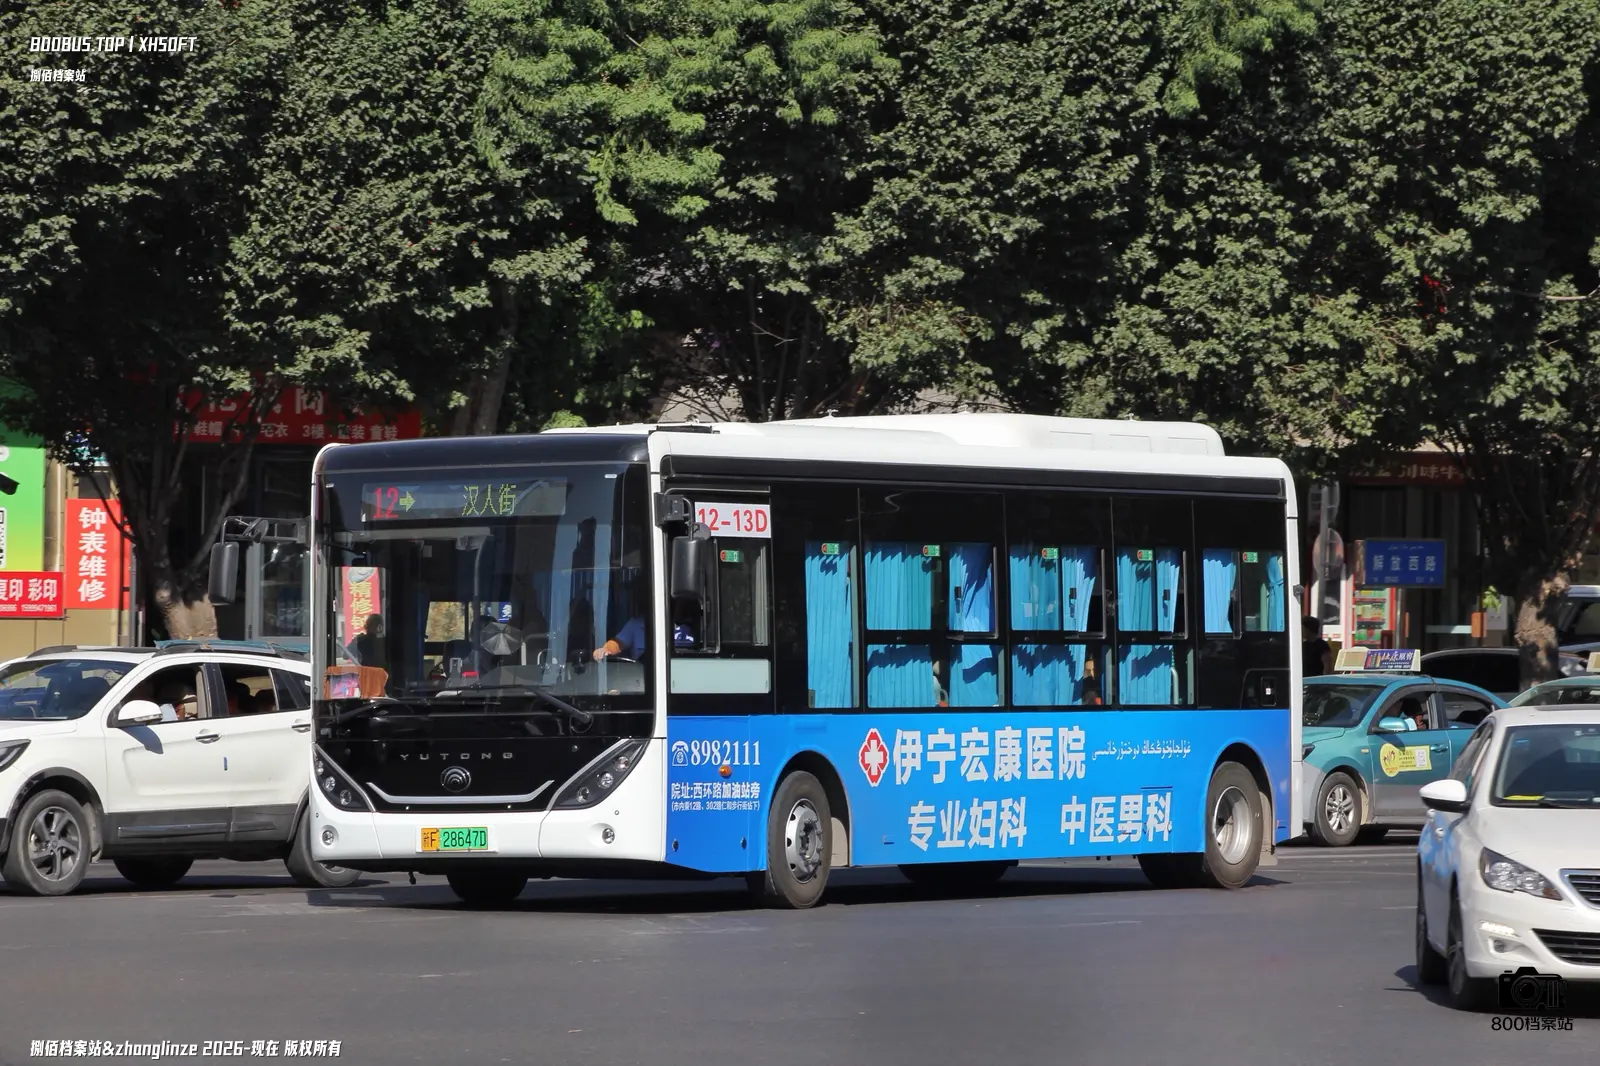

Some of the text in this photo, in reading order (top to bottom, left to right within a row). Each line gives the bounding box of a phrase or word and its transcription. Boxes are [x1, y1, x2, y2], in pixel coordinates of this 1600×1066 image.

[373, 484, 517, 519] 12 汉人街
[698, 508, 768, 533] 12-13D
[78, 507, 107, 602] 钟表维修
[28, 578, 57, 601] 彩印
[400, 752, 513, 760] YUTONG
[691, 740, 760, 766] 8982111
[893, 725, 1086, 785] 伊宁宏康医院
[908, 792, 1173, 851] 专业妇科 中医男科
[443, 830, 487, 847] 28647D
